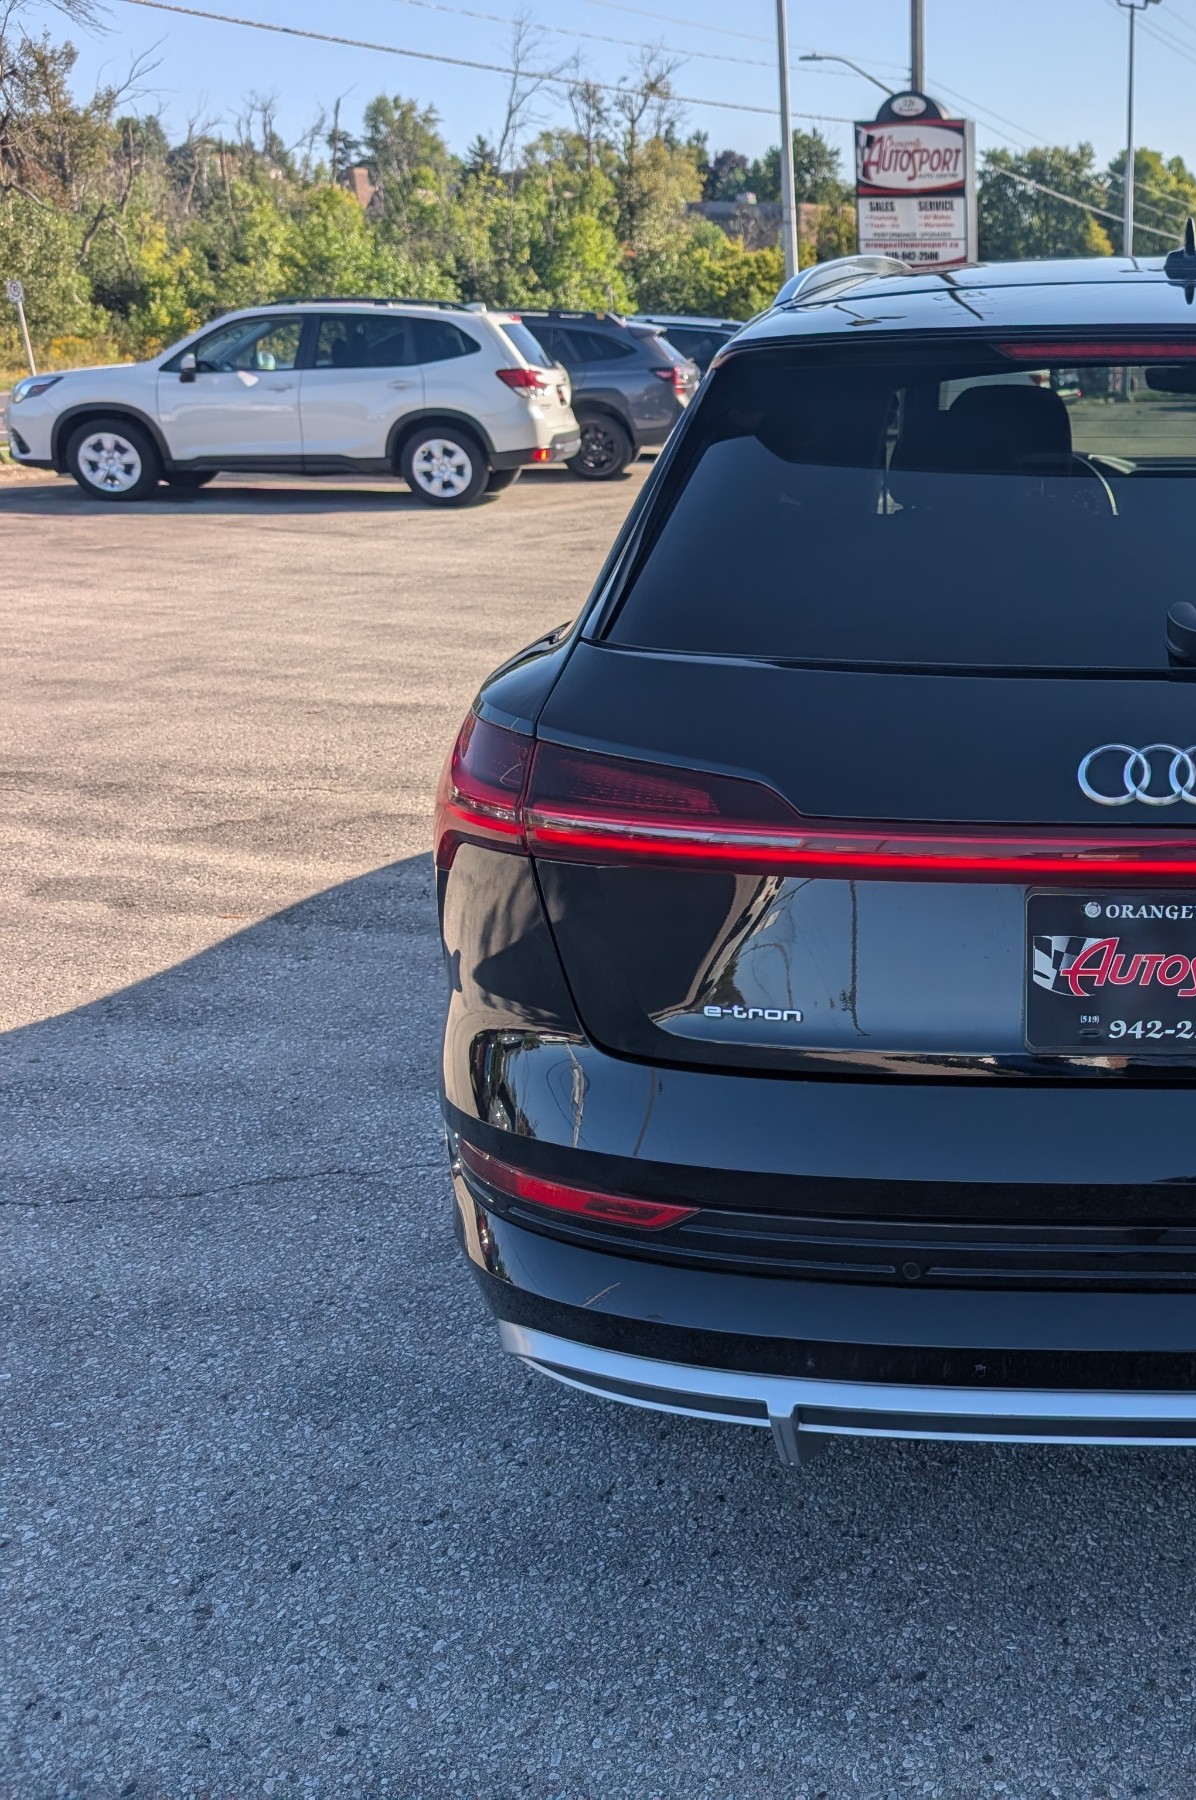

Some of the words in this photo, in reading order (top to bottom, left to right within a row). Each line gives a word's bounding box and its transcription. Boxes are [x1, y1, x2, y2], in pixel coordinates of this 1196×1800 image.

[864, 135, 962, 181] AUTOSPORT
[869, 201, 896, 212] SALES
[918, 200, 954, 212] SERVICE
[703, 1005, 802, 1022] e-tron
[1080, 1014, 1100, 1024] (519)
